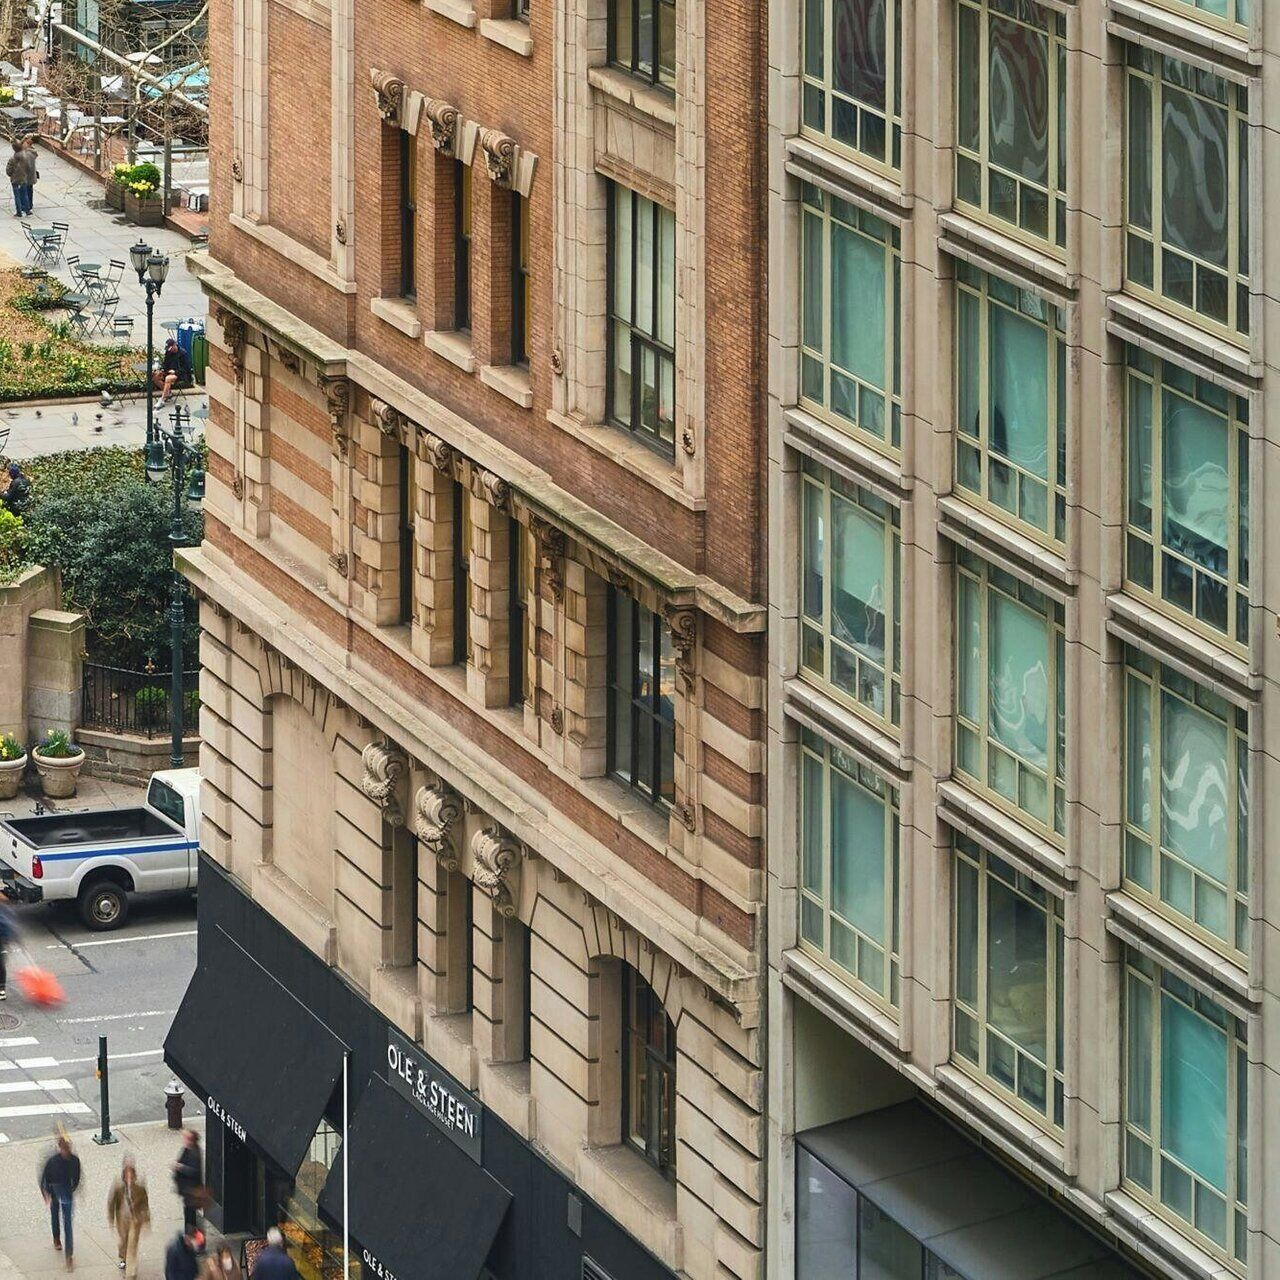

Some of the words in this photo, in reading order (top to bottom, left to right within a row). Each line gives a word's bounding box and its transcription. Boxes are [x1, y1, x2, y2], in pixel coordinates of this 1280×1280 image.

[388, 1044, 413, 1085] OLE
[417, 1069, 427, 1097] &
[430, 1080, 474, 1138] STEEN
[207, 1095, 220, 1117] OLE
[220, 1108, 226, 1122] &
[226, 1114, 247, 1143] STEEN
[363, 1249, 377, 1272] OLE
[377, 1263, 383, 1278] &
